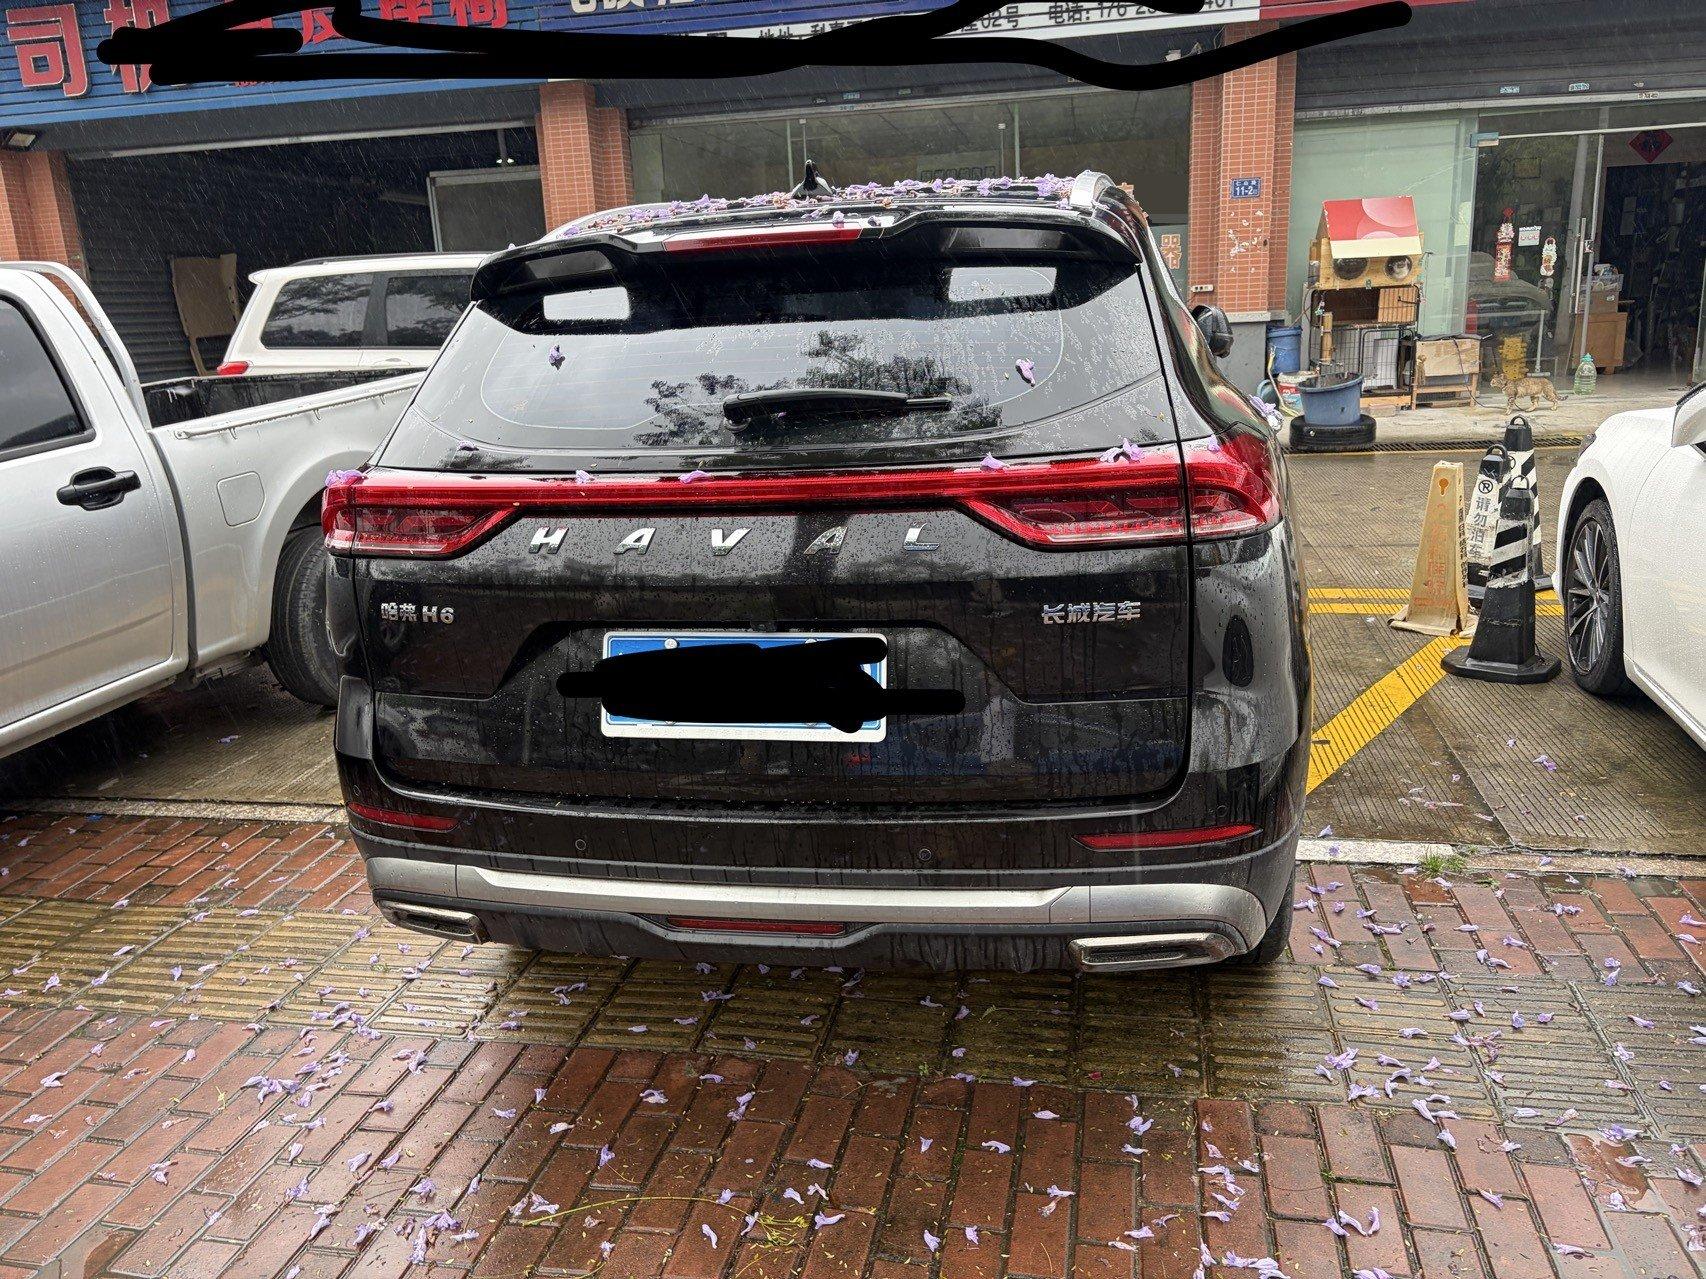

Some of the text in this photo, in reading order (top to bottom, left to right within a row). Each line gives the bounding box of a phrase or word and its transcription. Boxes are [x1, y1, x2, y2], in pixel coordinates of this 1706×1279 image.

[528, 523, 942, 556] HAVAL
[1041, 600, 1141, 625] 长城汽车
